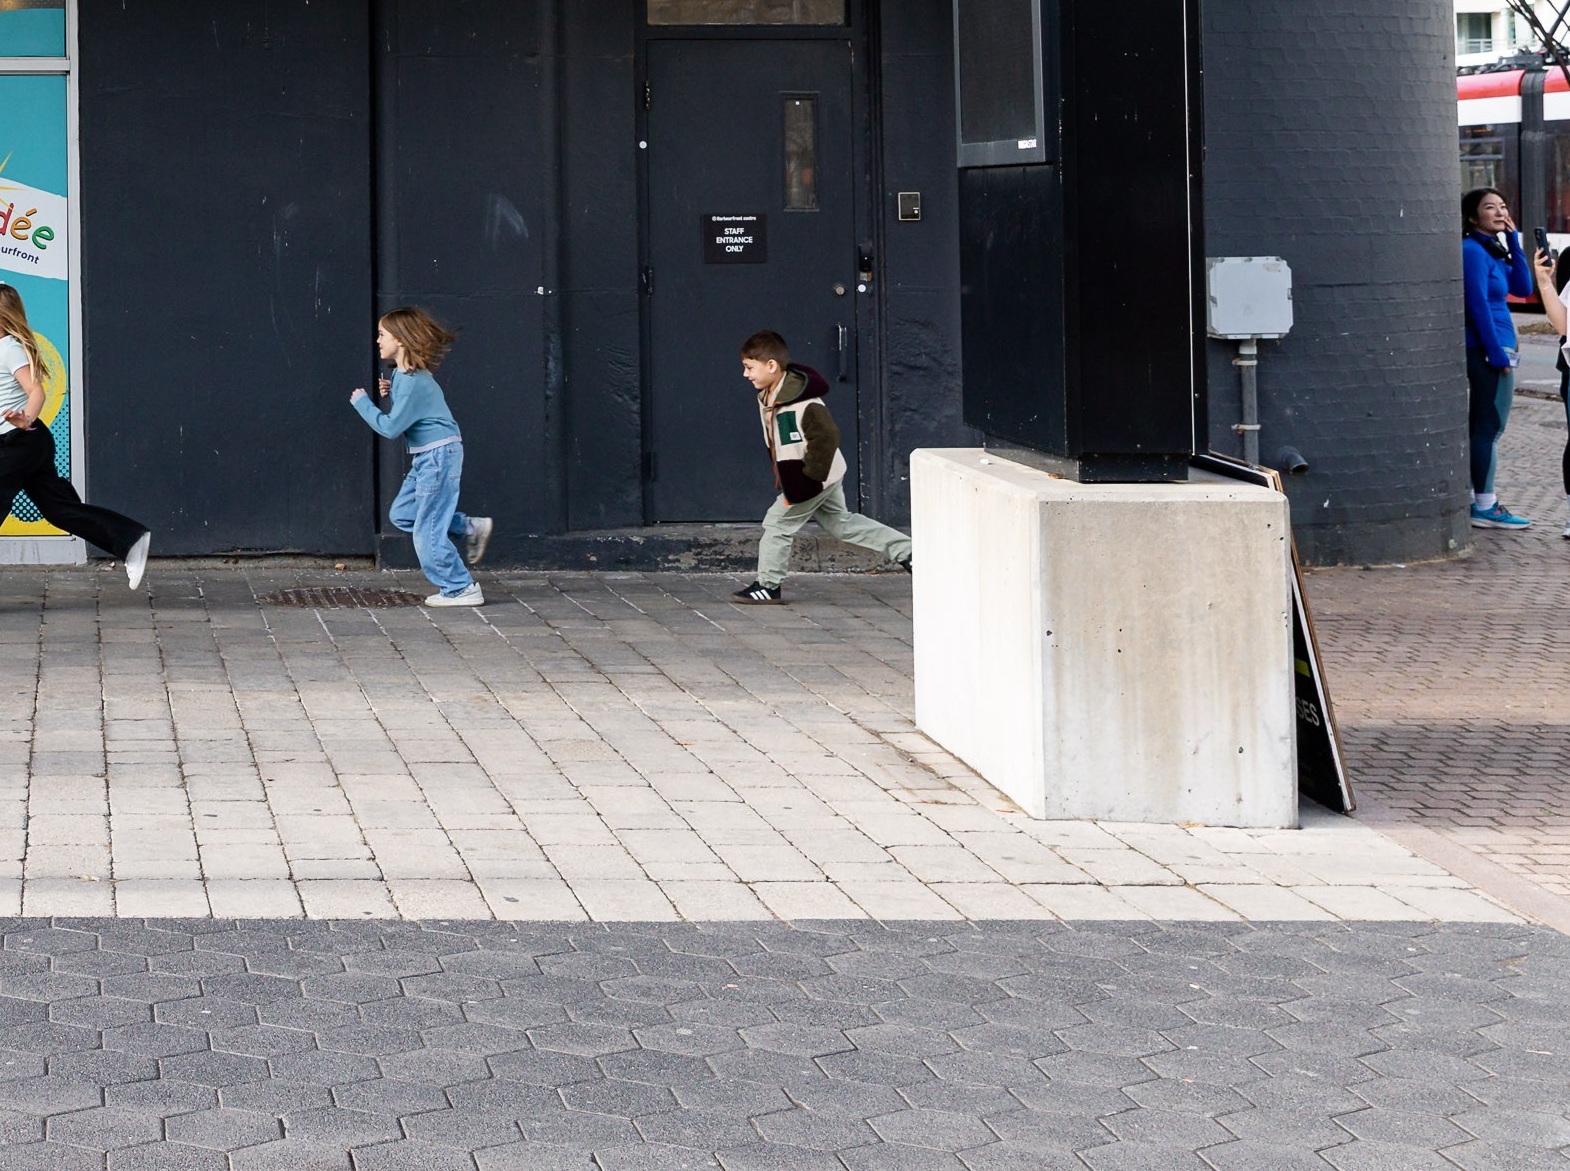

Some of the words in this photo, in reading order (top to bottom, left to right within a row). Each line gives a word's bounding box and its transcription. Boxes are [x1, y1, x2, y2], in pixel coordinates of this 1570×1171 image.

[724, 227, 745, 235] STAFF
[716, 236, 753, 244] ENTRANCE
[725, 245, 744, 253] ONLY
